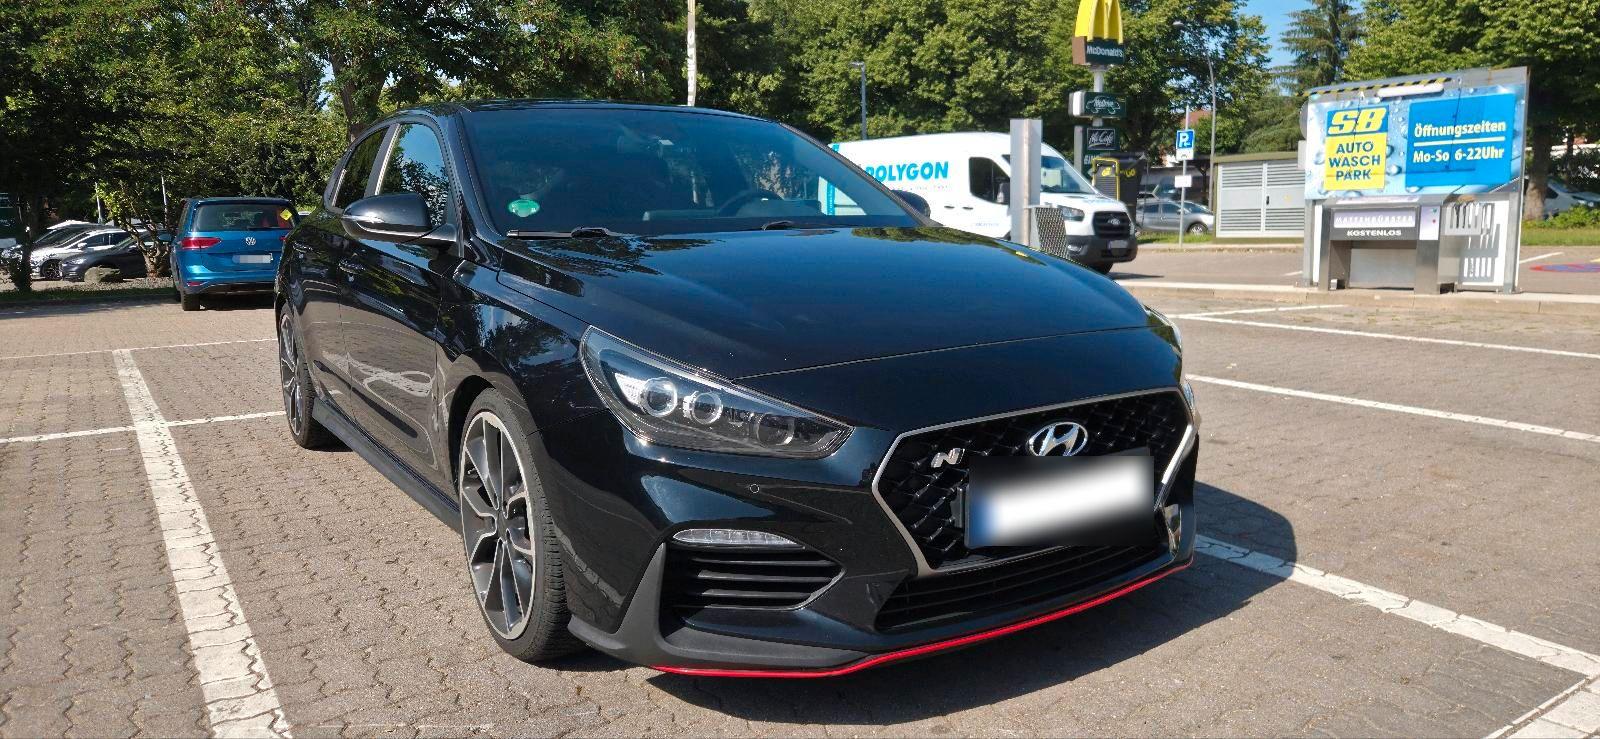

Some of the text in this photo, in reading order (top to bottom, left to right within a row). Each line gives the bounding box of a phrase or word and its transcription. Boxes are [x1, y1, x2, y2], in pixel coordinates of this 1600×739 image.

[1086, 45, 1124, 57] McDonald's
[1328, 107, 1387, 134] SB
[1414, 120, 1506, 137] Öffnungszeiten
[1336, 141, 1374, 154] AUTO
[1328, 154, 1381, 168] WASCH
[1413, 146, 1505, 163] Mo-So 6-22Uhr
[1335, 169, 1372, 181] PARK
[1346, 229, 1402, 237] KOSTENLOS
